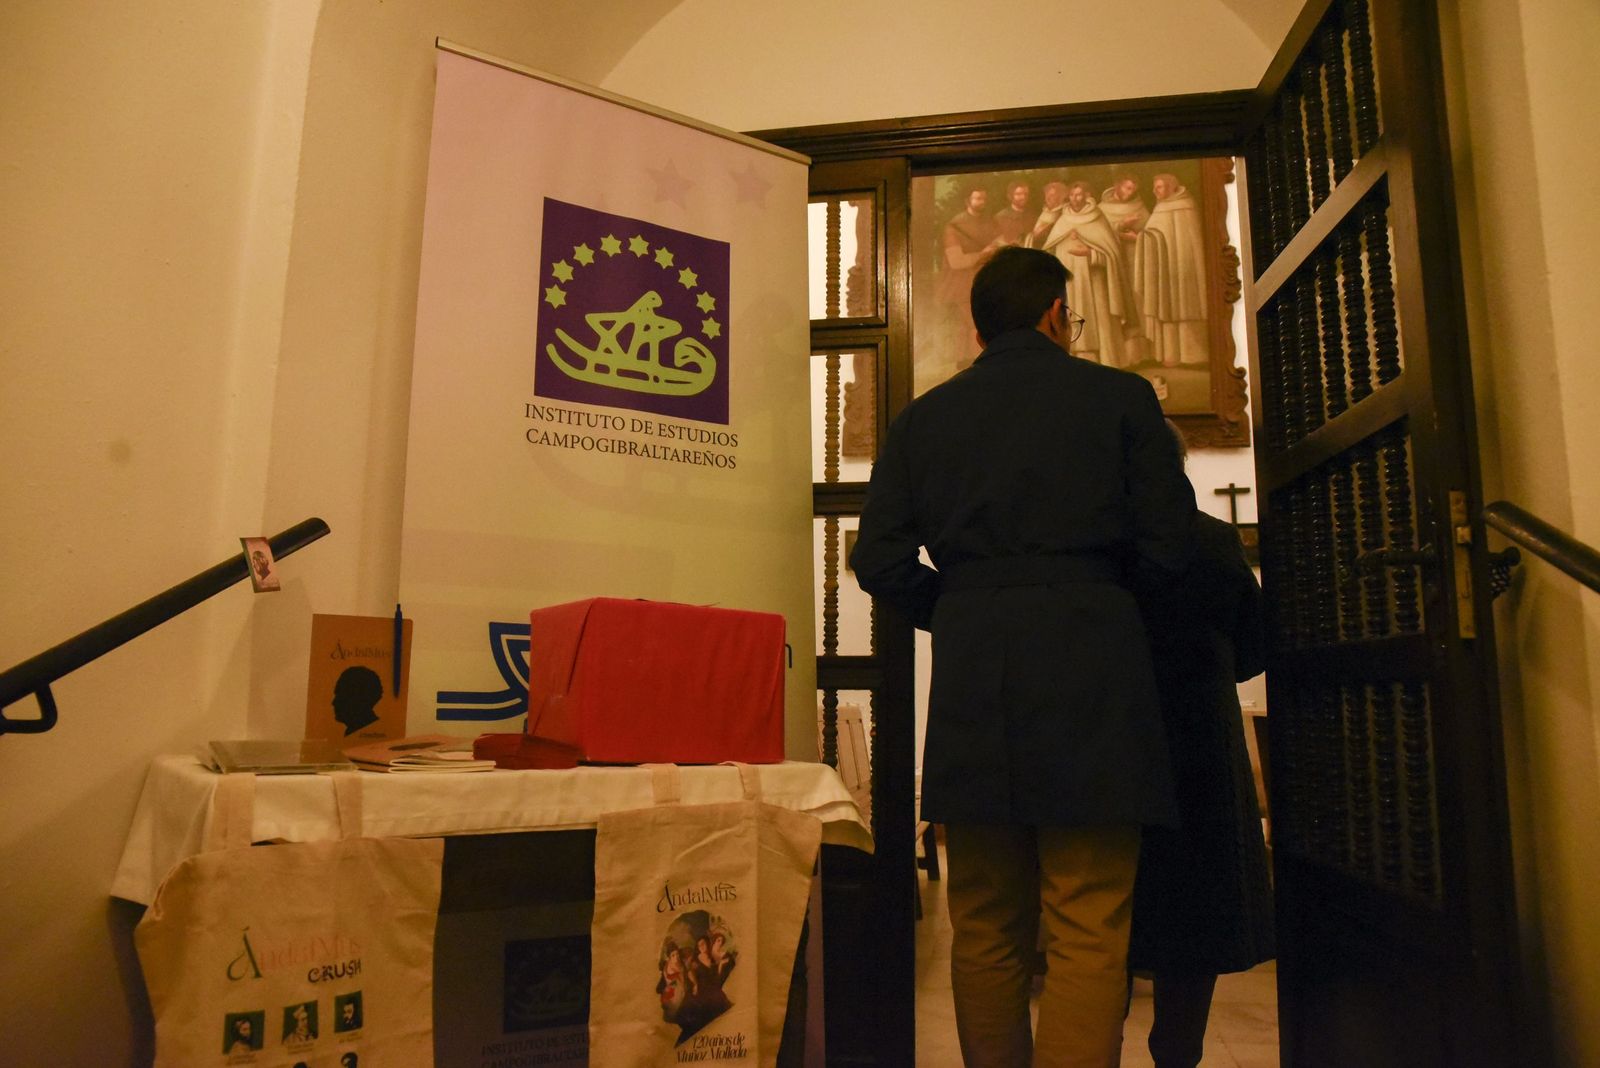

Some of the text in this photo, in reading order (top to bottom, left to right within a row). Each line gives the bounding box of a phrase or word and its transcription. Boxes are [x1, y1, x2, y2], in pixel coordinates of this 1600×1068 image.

[524, 403, 739, 448] INSTITUTO DE ESTUDIOS
[525, 428, 737, 469] CAMPOGIBRALTAREÑOS
[307, 959, 362, 983] CRUSH
[709, 1033, 733, 1047] años
[733, 1032, 746, 1046] de
[676, 1045, 748, 1063] Muñoz Molleda
